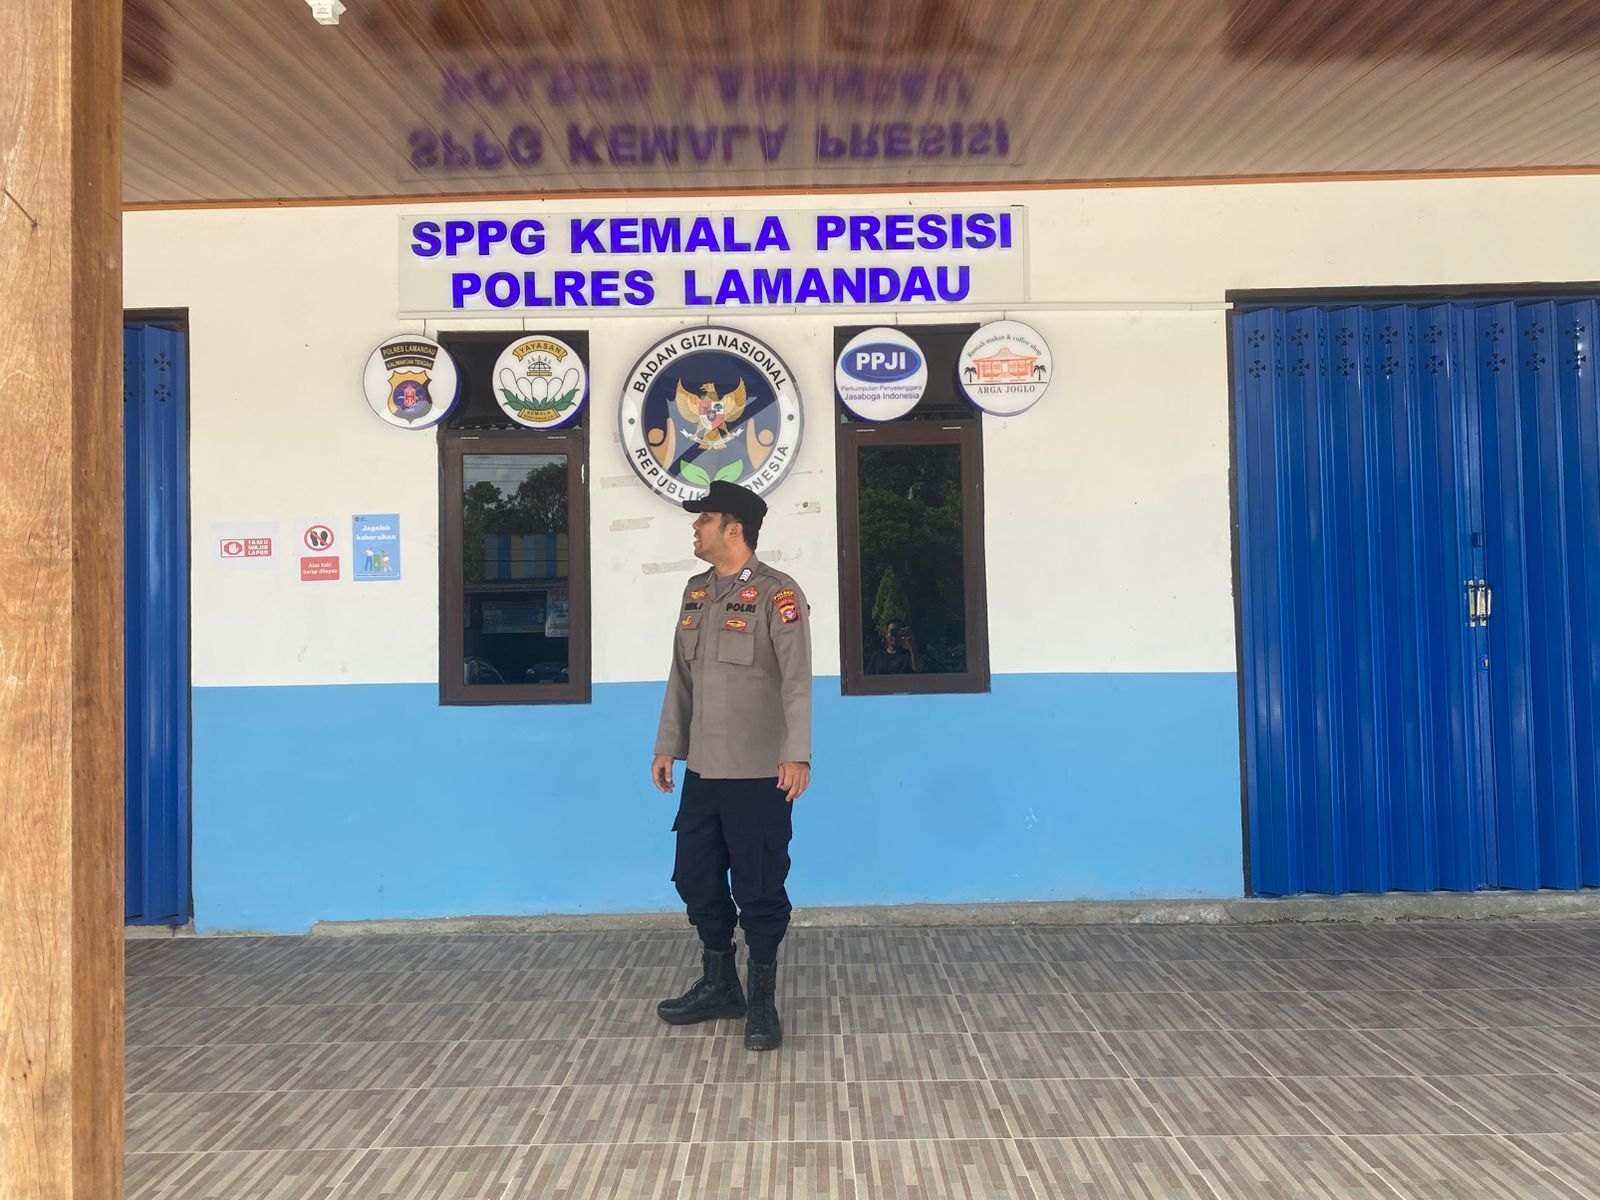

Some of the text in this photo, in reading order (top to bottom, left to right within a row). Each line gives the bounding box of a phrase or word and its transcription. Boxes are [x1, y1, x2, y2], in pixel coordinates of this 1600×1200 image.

[411, 213, 1011, 257] SPPG KEMALA PRESISI
[452, 266, 970, 308] POLRES LAMANDAU
[383, 345, 436, 356] POLRES LAMANDAU
[519, 342, 562, 354] YAYASAN
[633, 334, 787, 393] BADAN GIZI NASIONAL
[856, 352, 906, 370] PPJI
[880, 384, 923, 392] Penyelenggara
[977, 385, 1036, 394] ARGA JOGLO
[844, 392, 920, 401] Jasaboga Indonesia
[635, 445, 789, 501] REPUBLIK NESIA
[726, 602, 757, 613] POLRI
